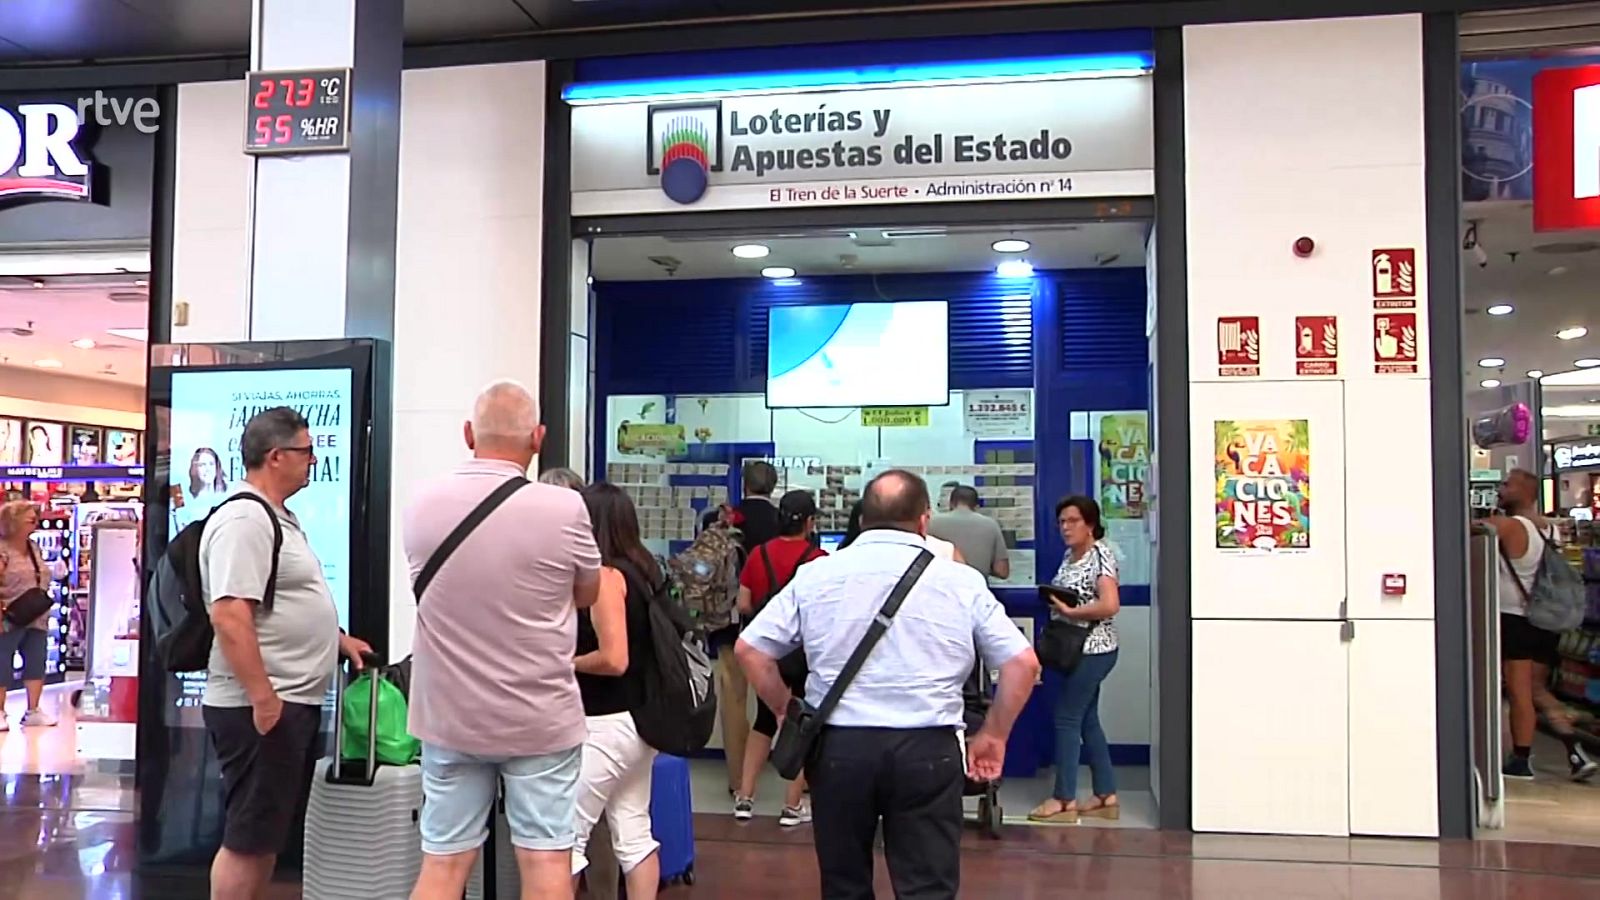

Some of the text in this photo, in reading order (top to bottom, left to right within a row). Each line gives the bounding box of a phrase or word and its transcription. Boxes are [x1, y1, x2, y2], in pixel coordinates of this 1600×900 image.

[255, 114, 339, 144] 55 %HR
[730, 104, 891, 142] Loterías y
[730, 130, 1073, 176] Apuestas del Estado
[770, 188, 782, 202] El
[786, 187, 817, 201] Tren
[821, 186, 839, 200] de
[844, 185, 858, 199] la
[861, 184, 909, 199] Suerte
[926, 178, 1036, 197] Administración
[1059, 178, 1073, 193] 14
[1244, 433, 1279, 456] VA
[1241, 454, 1284, 477] CA
[1235, 479, 1290, 503] CIO
[1234, 500, 1291, 527] NES
